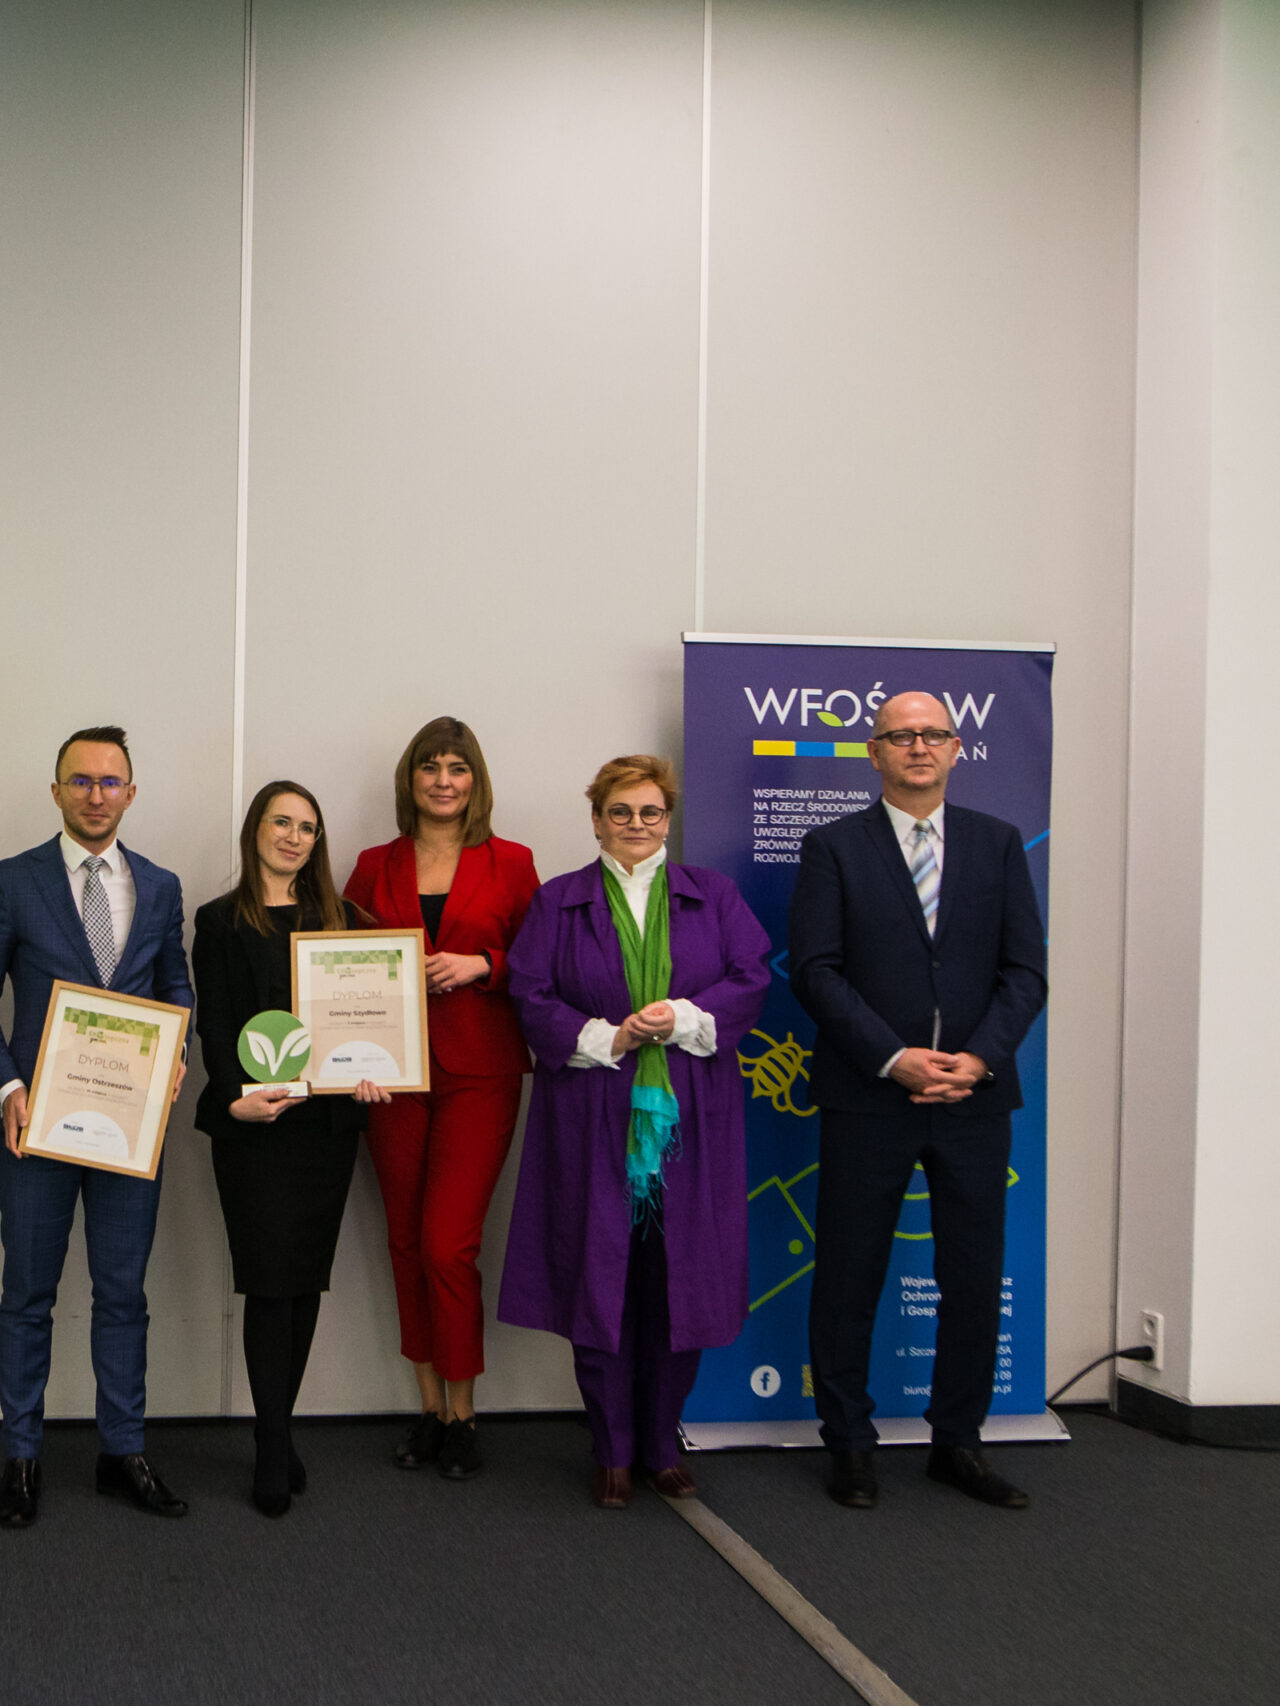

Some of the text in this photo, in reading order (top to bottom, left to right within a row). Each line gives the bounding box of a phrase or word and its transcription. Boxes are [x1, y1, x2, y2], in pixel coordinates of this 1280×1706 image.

[753, 788, 871, 800] WSPIERAMY DZIAŁANIA
[753, 801, 769, 811] NA
[771, 802, 805, 812] RZECZ
[753, 814, 767, 824] ZE
[332, 990, 382, 1001] DYPLOM
[328, 1010, 352, 1018] Gminy
[78, 1054, 129, 1072] DYPLOM
[67, 1073, 91, 1084] Gminy
